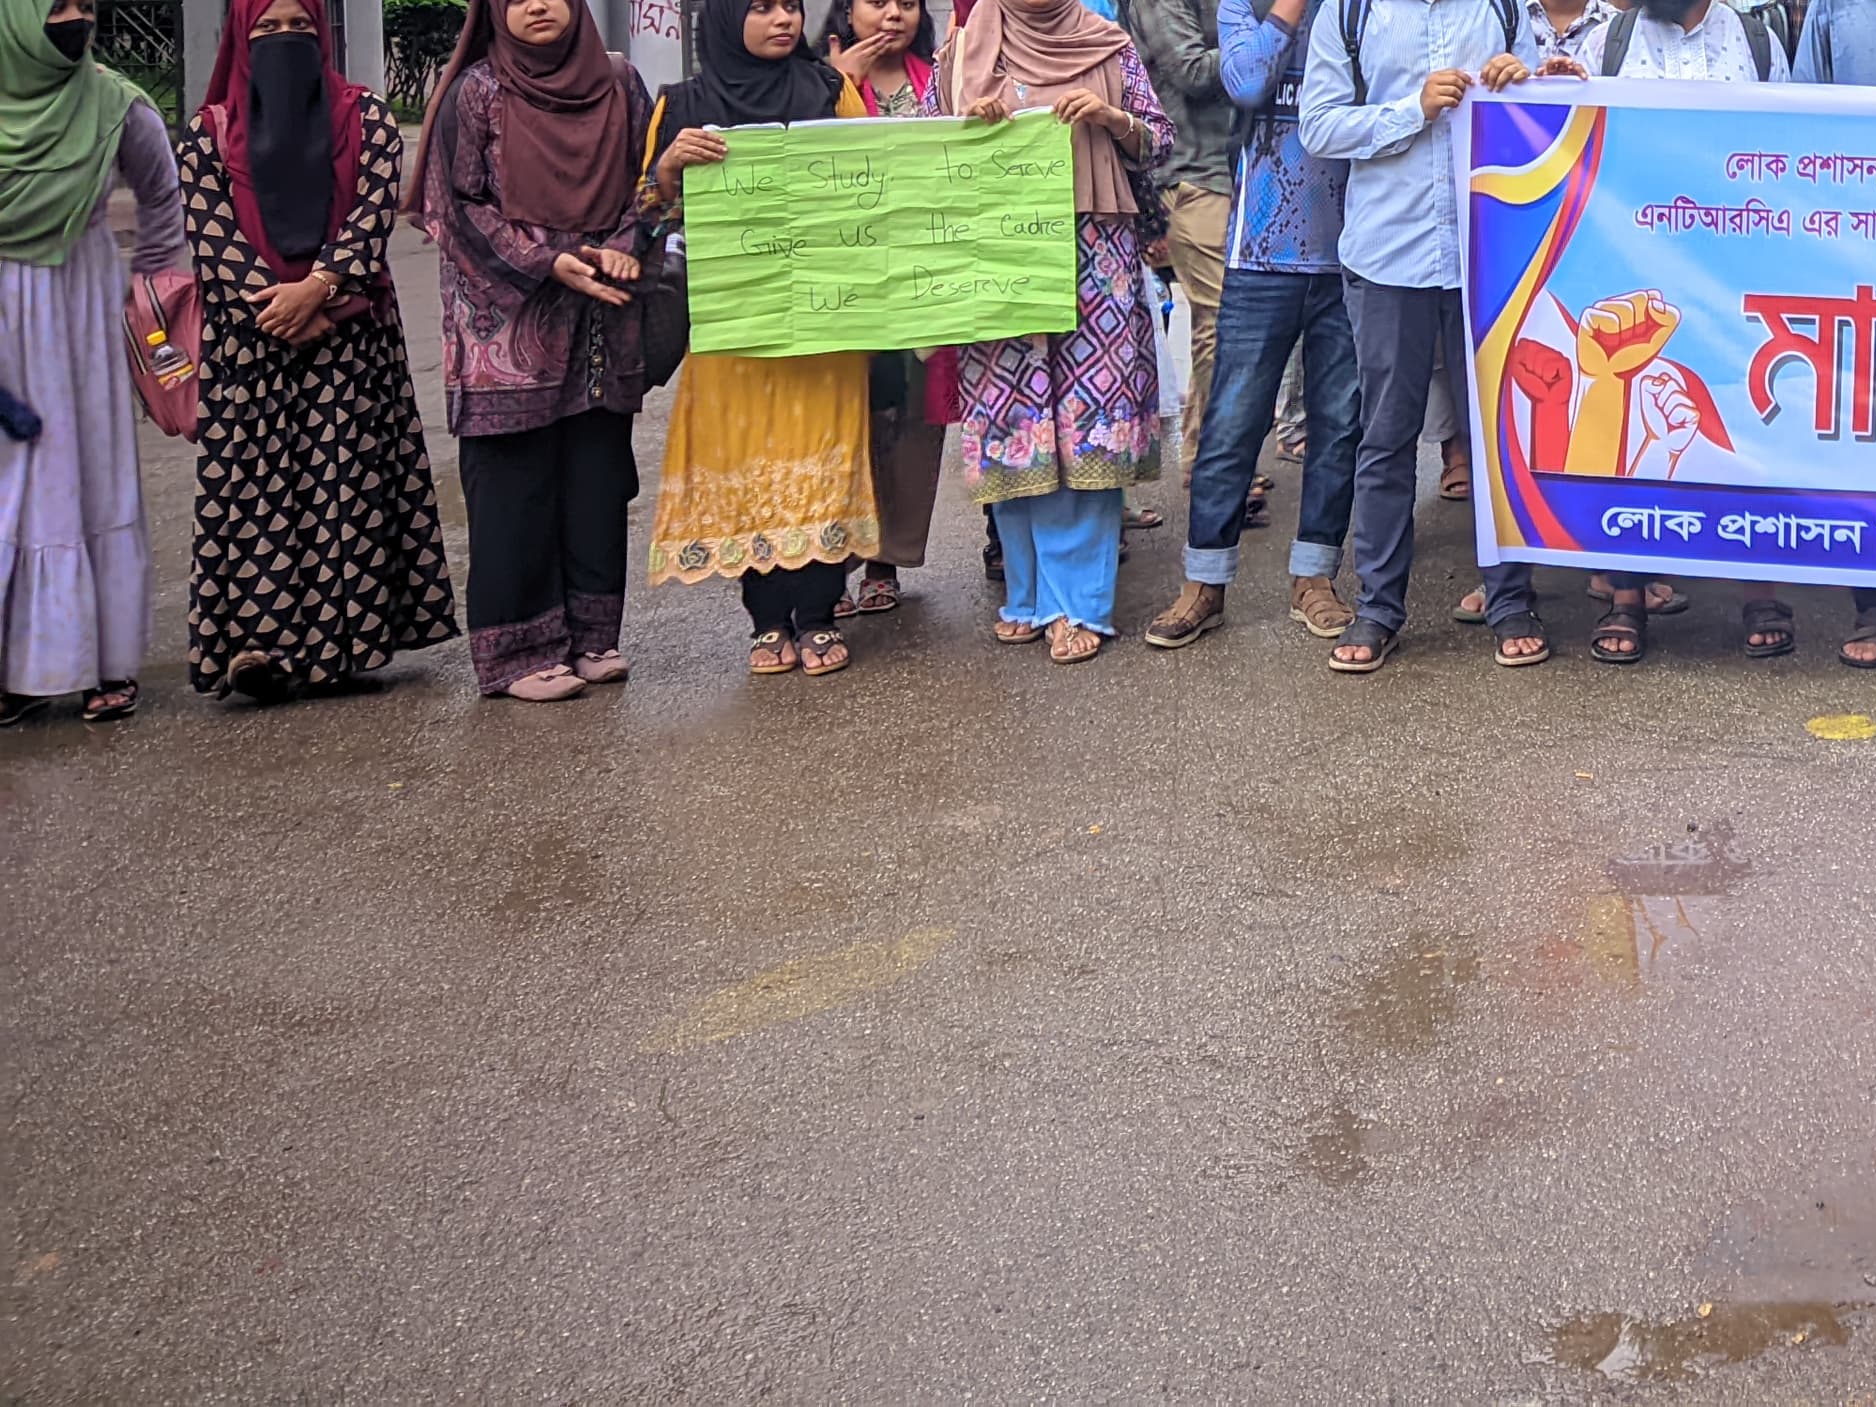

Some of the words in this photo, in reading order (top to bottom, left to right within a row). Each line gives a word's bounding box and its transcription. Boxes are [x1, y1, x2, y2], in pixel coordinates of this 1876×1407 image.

[721, 165, 776, 197] We
[935, 144, 974, 184] to
[991, 149, 1066, 180] Serve
[1725, 152, 1788, 183] লোক
[740, 228, 809, 260] Give
[924, 210, 971, 245] the
[1634, 195, 1792, 239] এনটিআরসিএ
[1802, 210, 1840, 241] এর
[809, 286, 859, 312] We
[911, 264, 1031, 301] Deserve
[1601, 503, 1704, 544] লোক
[1717, 511, 1869, 556] প্রশাসন
